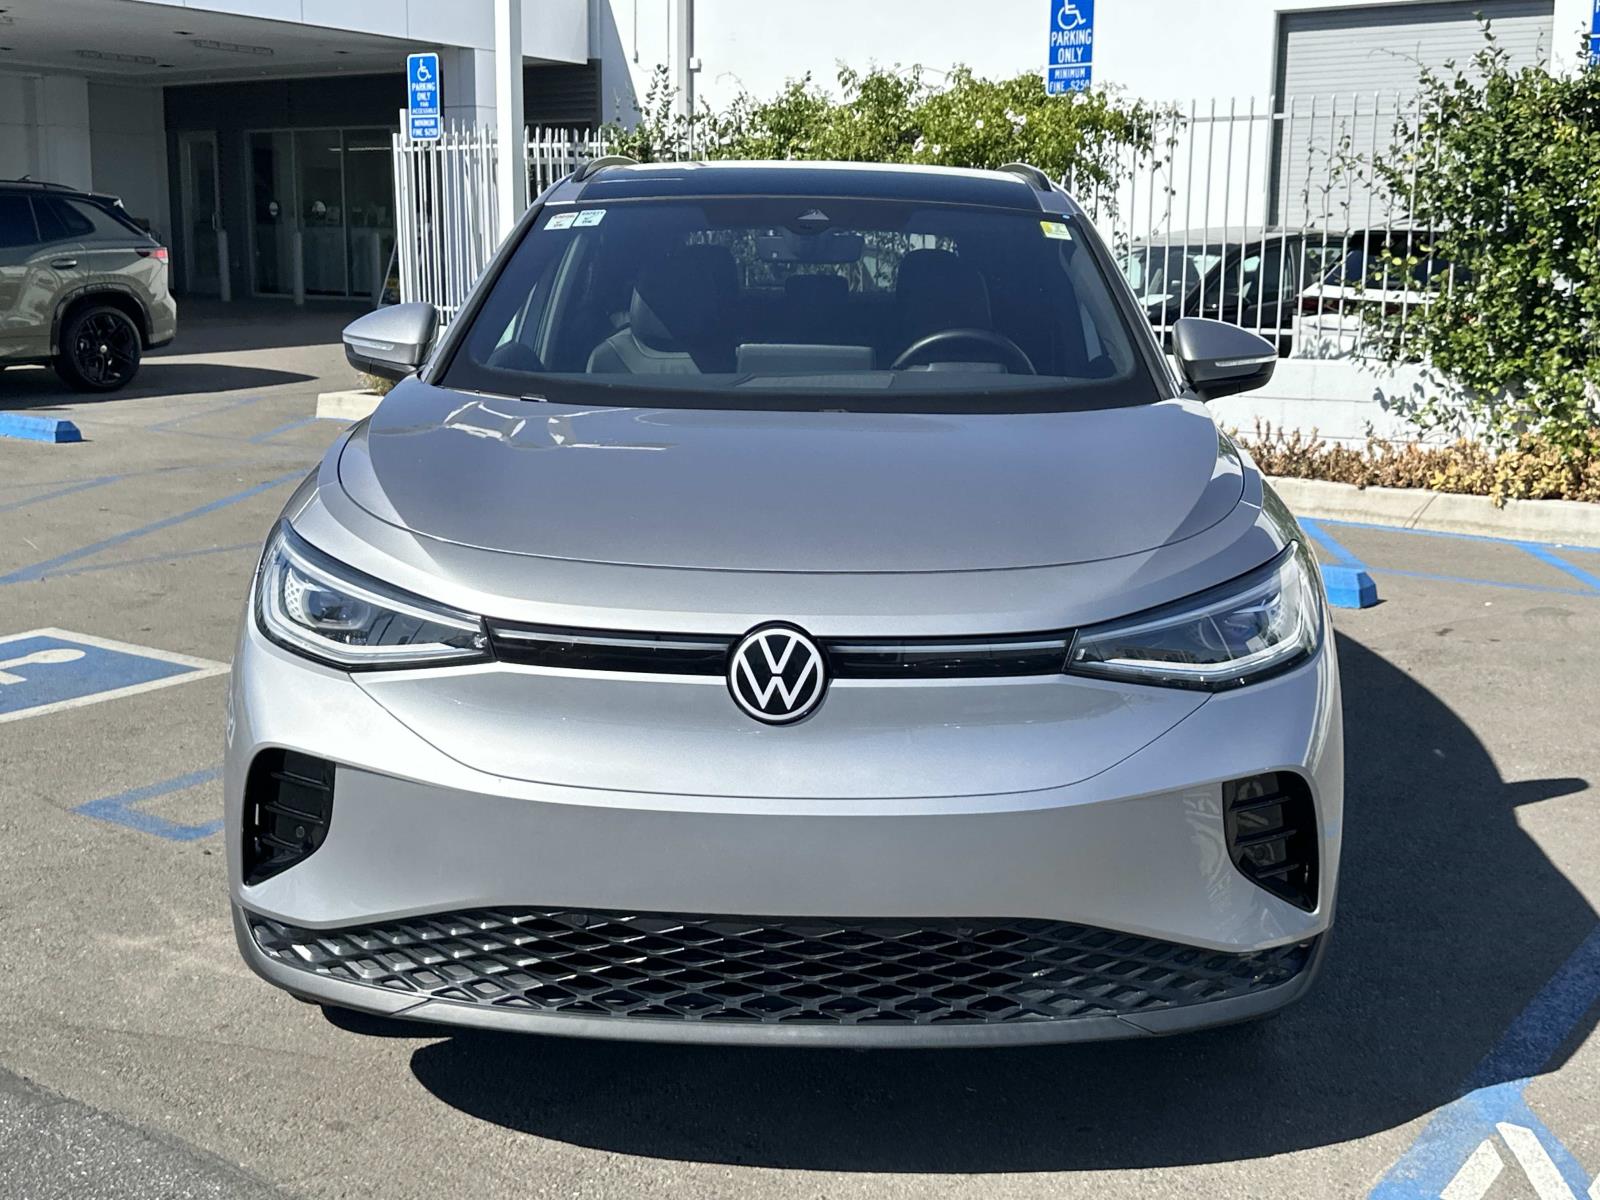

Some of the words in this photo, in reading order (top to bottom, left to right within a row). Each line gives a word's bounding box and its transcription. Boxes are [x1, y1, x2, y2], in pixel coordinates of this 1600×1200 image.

[1051, 29, 1092, 47] PARKING
[1057, 47, 1083, 63] ONLY
[1054, 67, 1086, 79] MINIMUM
[411, 82, 436, 91] PARKING
[1049, 80, 1065, 92] FINE
[416, 92, 431, 101] ONLY
[735, 631, 820, 712] VW
